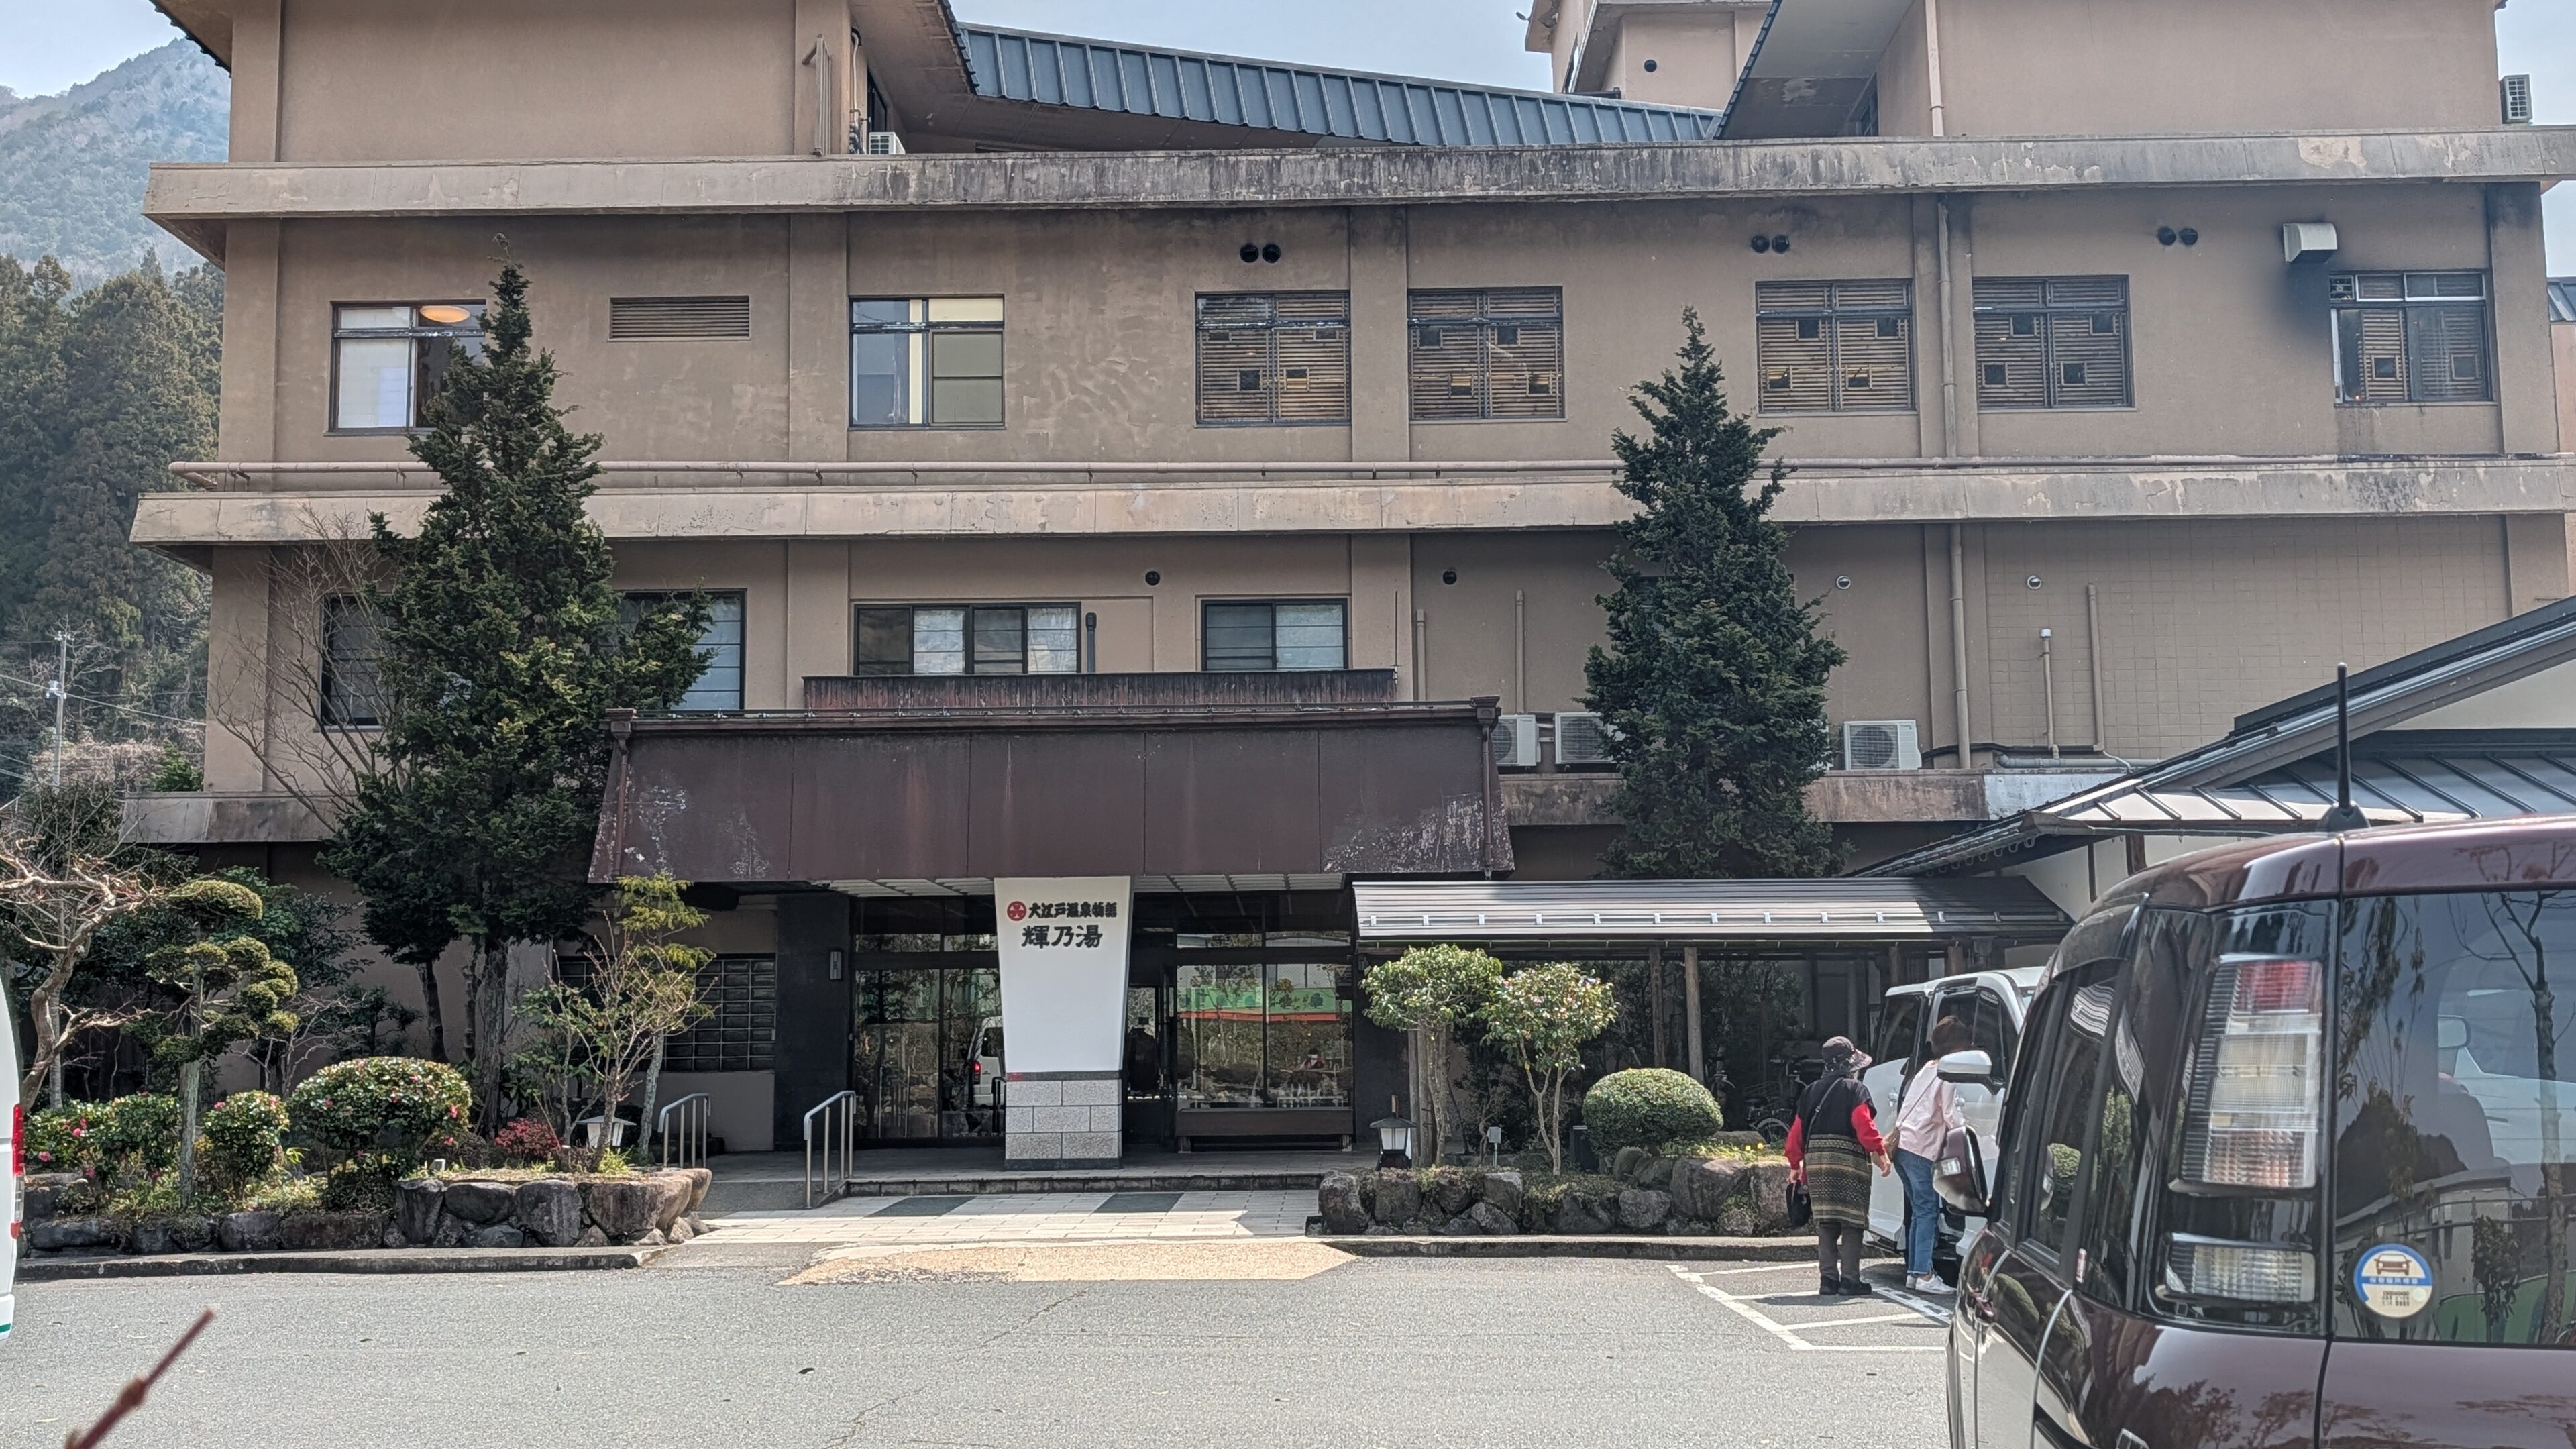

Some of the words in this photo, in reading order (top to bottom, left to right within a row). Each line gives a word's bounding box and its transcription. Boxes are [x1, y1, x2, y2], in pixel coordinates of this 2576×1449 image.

[1028, 902, 1117, 918] 大江戸温泉物語
[1021, 925, 1103, 949] 輝乃湯
